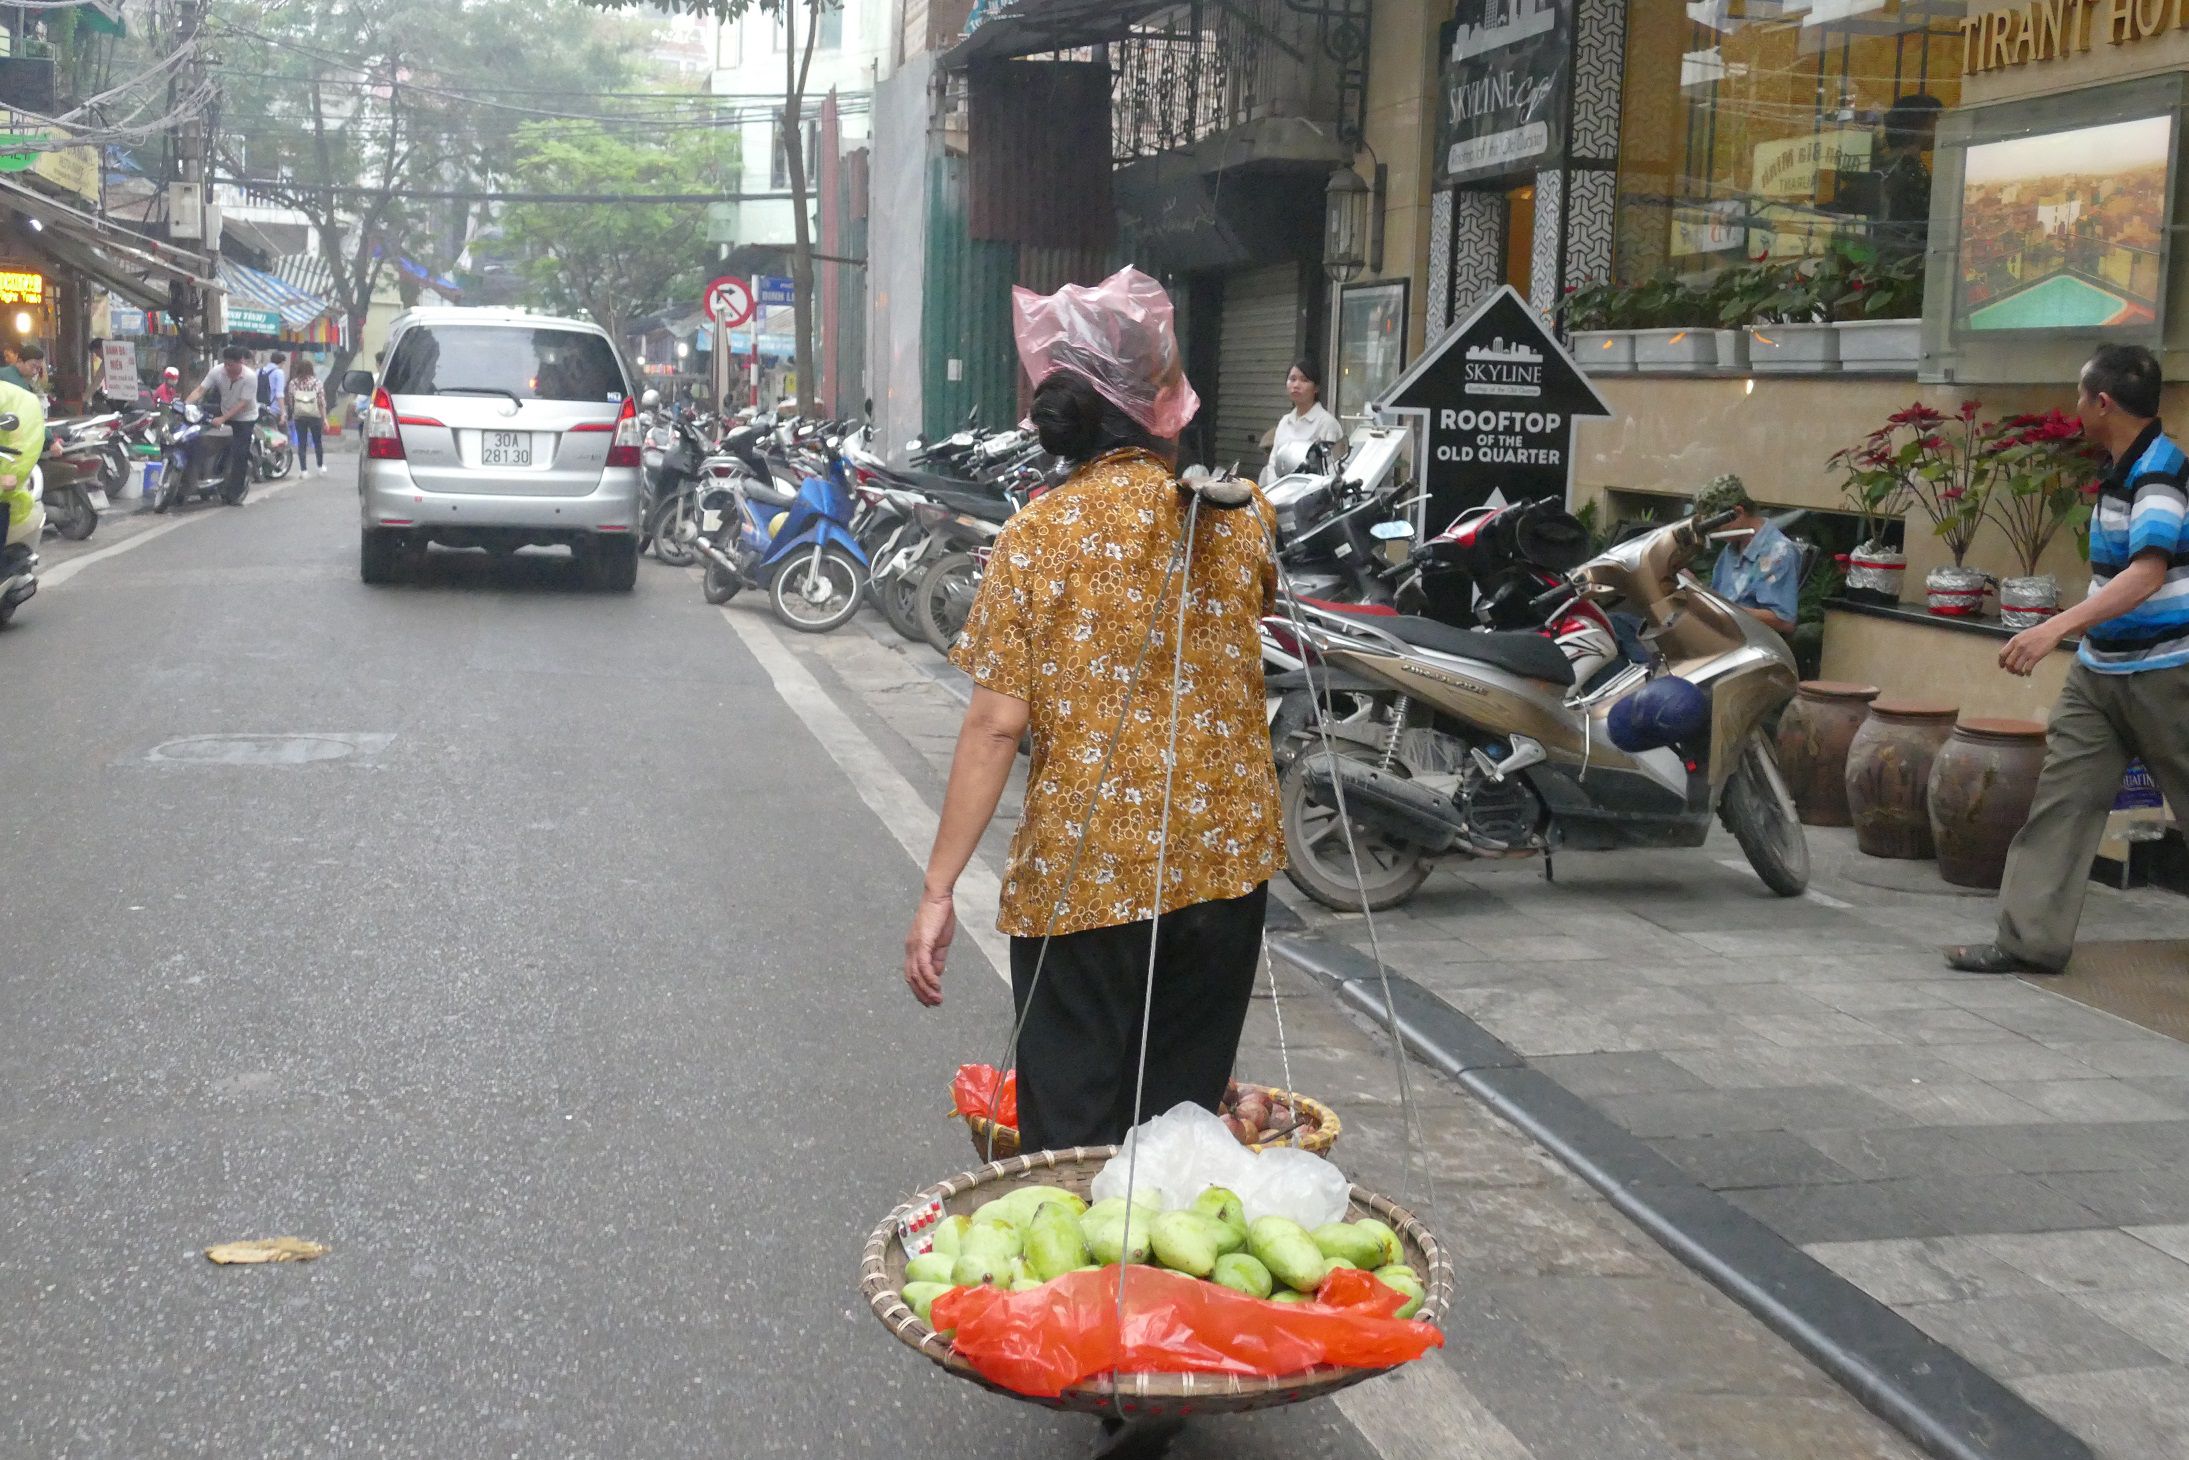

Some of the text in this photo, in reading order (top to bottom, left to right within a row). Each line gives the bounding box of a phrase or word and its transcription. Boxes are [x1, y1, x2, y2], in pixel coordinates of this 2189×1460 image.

[1959, 0, 2088, 75] TIRANT
[1449, 65, 1515, 125] SKYLINE
[1465, 363, 1542, 383] SKYLINE
[1440, 409, 1561, 433] ROOFTOP
[494, 432, 520, 448] 30A
[1476, 434, 1523, 447] OF THE
[484, 449, 529, 463] 28130
[1437, 446, 1560, 464] OLD QUARTER
